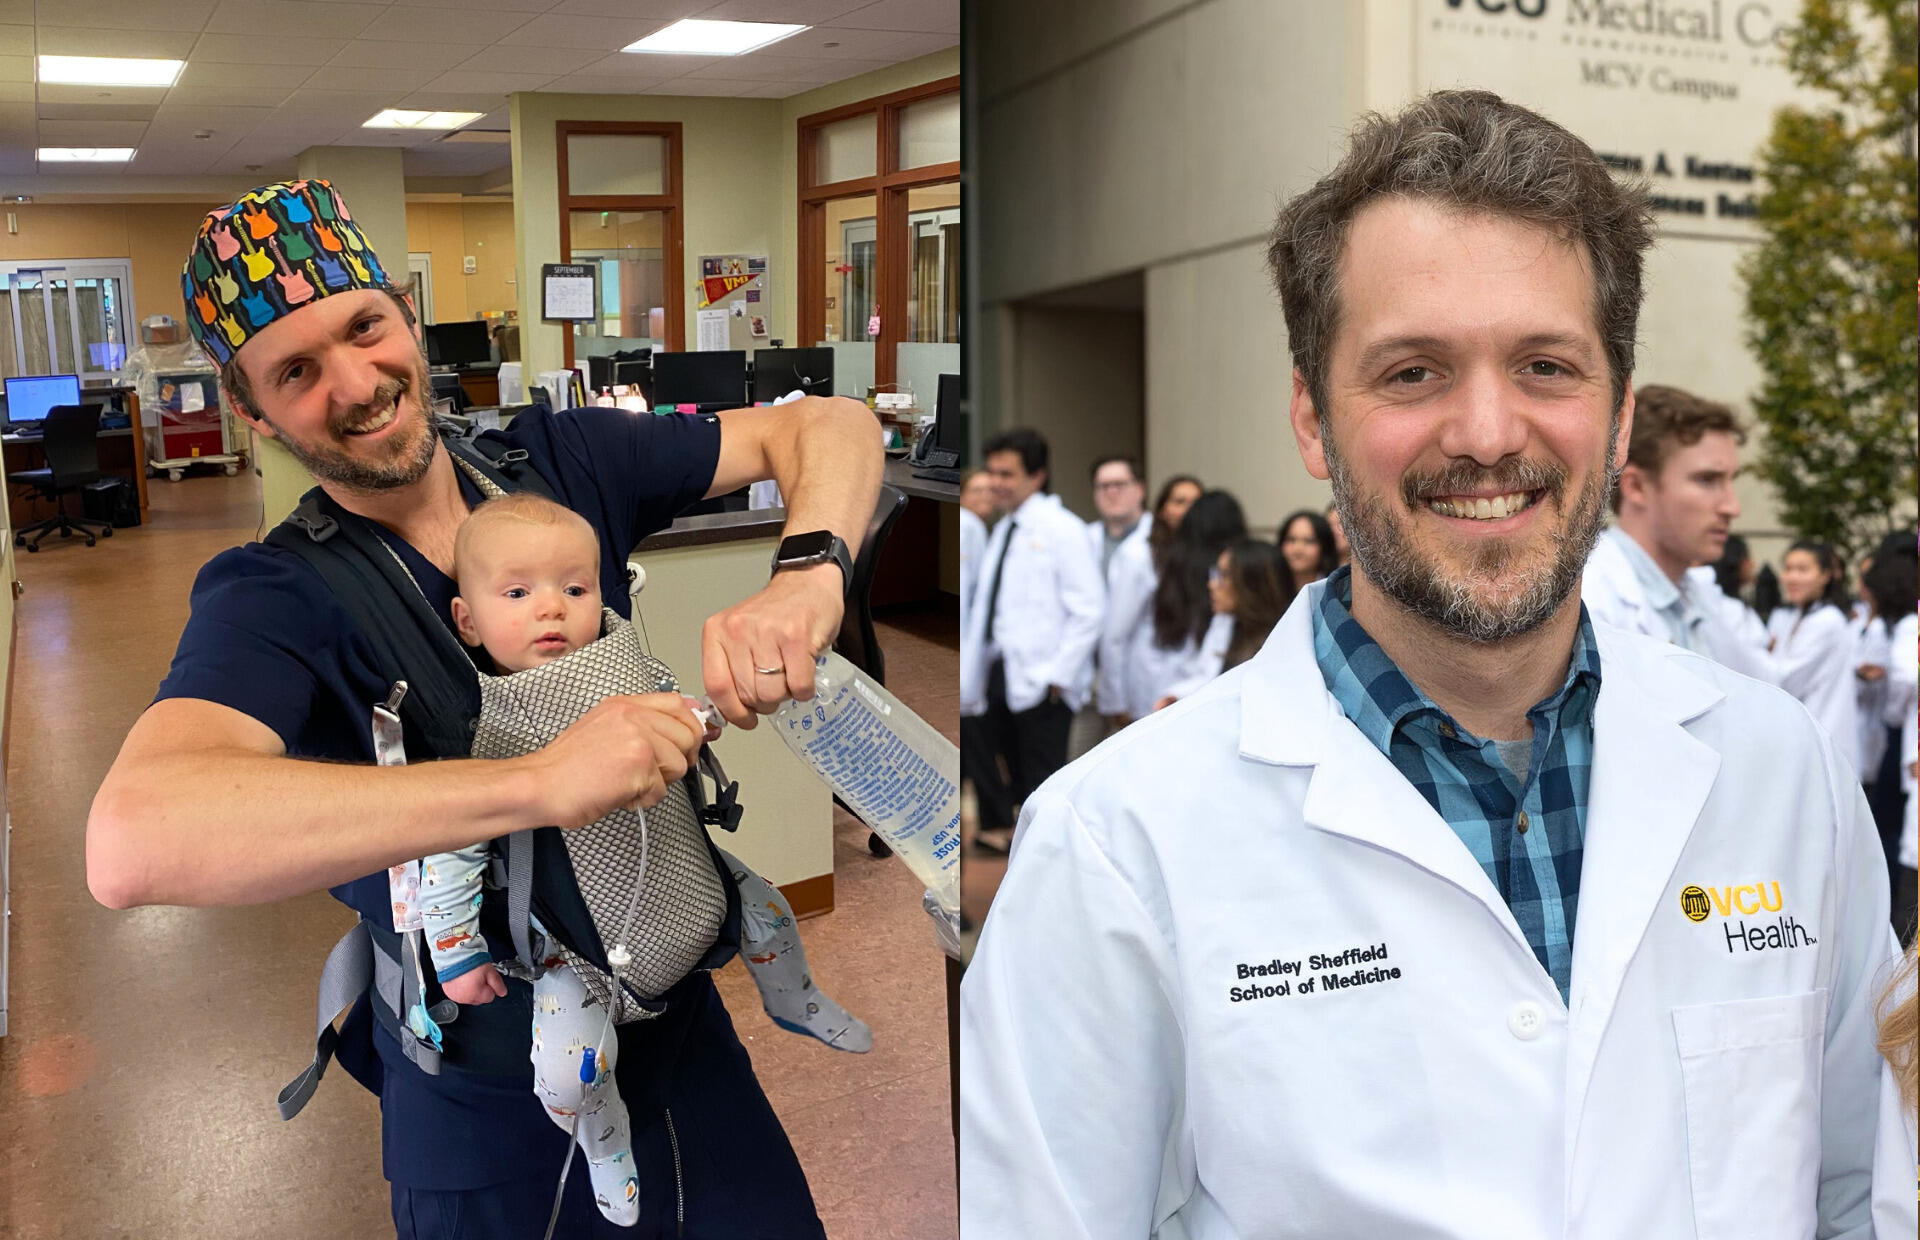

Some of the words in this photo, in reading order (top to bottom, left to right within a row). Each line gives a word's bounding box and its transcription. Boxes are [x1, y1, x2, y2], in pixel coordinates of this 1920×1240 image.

[1564, 0, 1722, 42] Medical
[1649, 66, 1740, 101] Campus
[554, 266, 584, 274] SEPTEMBER
[723, 275, 749, 291] VMI
[932, 831, 950, 846] USP
[1707, 880, 1783, 917] VCU
[1723, 915, 1810, 954] Health
[1236, 959, 1302, 980] Bradley
[1308, 942, 1388, 971] Sheffield
[1229, 980, 1291, 1003] School
[1297, 977, 1315, 995] of
[1321, 966, 1402, 992] Medicine
